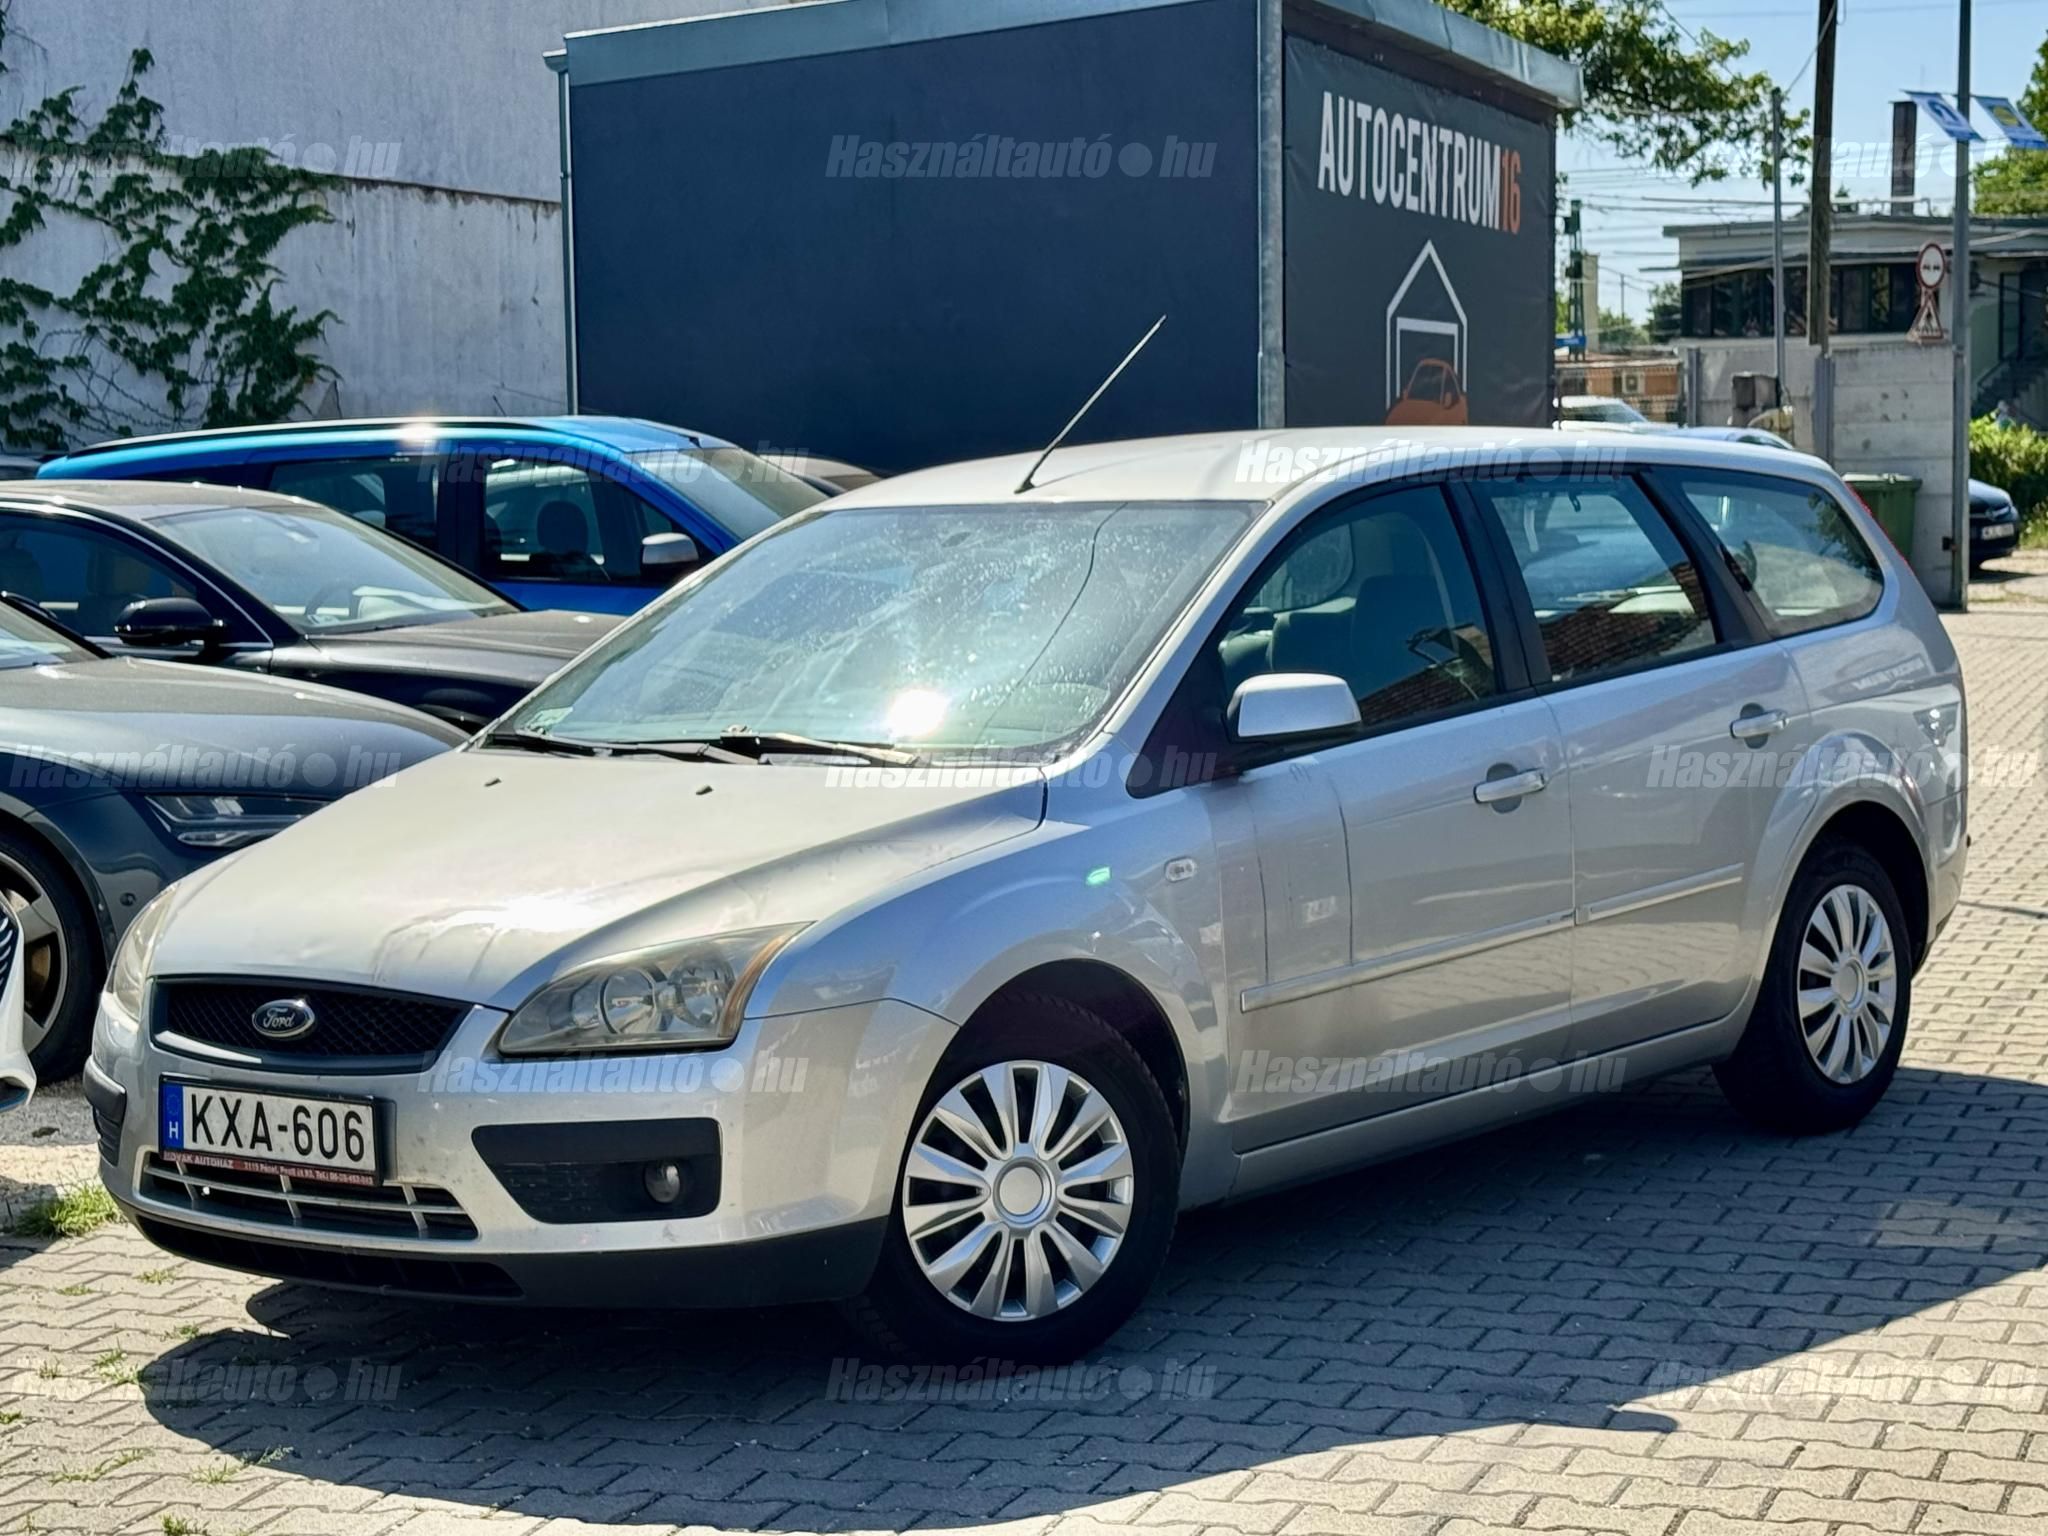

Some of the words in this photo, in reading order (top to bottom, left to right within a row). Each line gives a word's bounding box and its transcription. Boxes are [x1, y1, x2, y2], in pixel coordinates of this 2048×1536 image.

[1317, 91, 1521, 234] AUTOCENTRUM16
[263, 1007, 296, 1028] Ford
[169, 1120, 179, 1139] H
[191, 1093, 365, 1162] KXA-606
